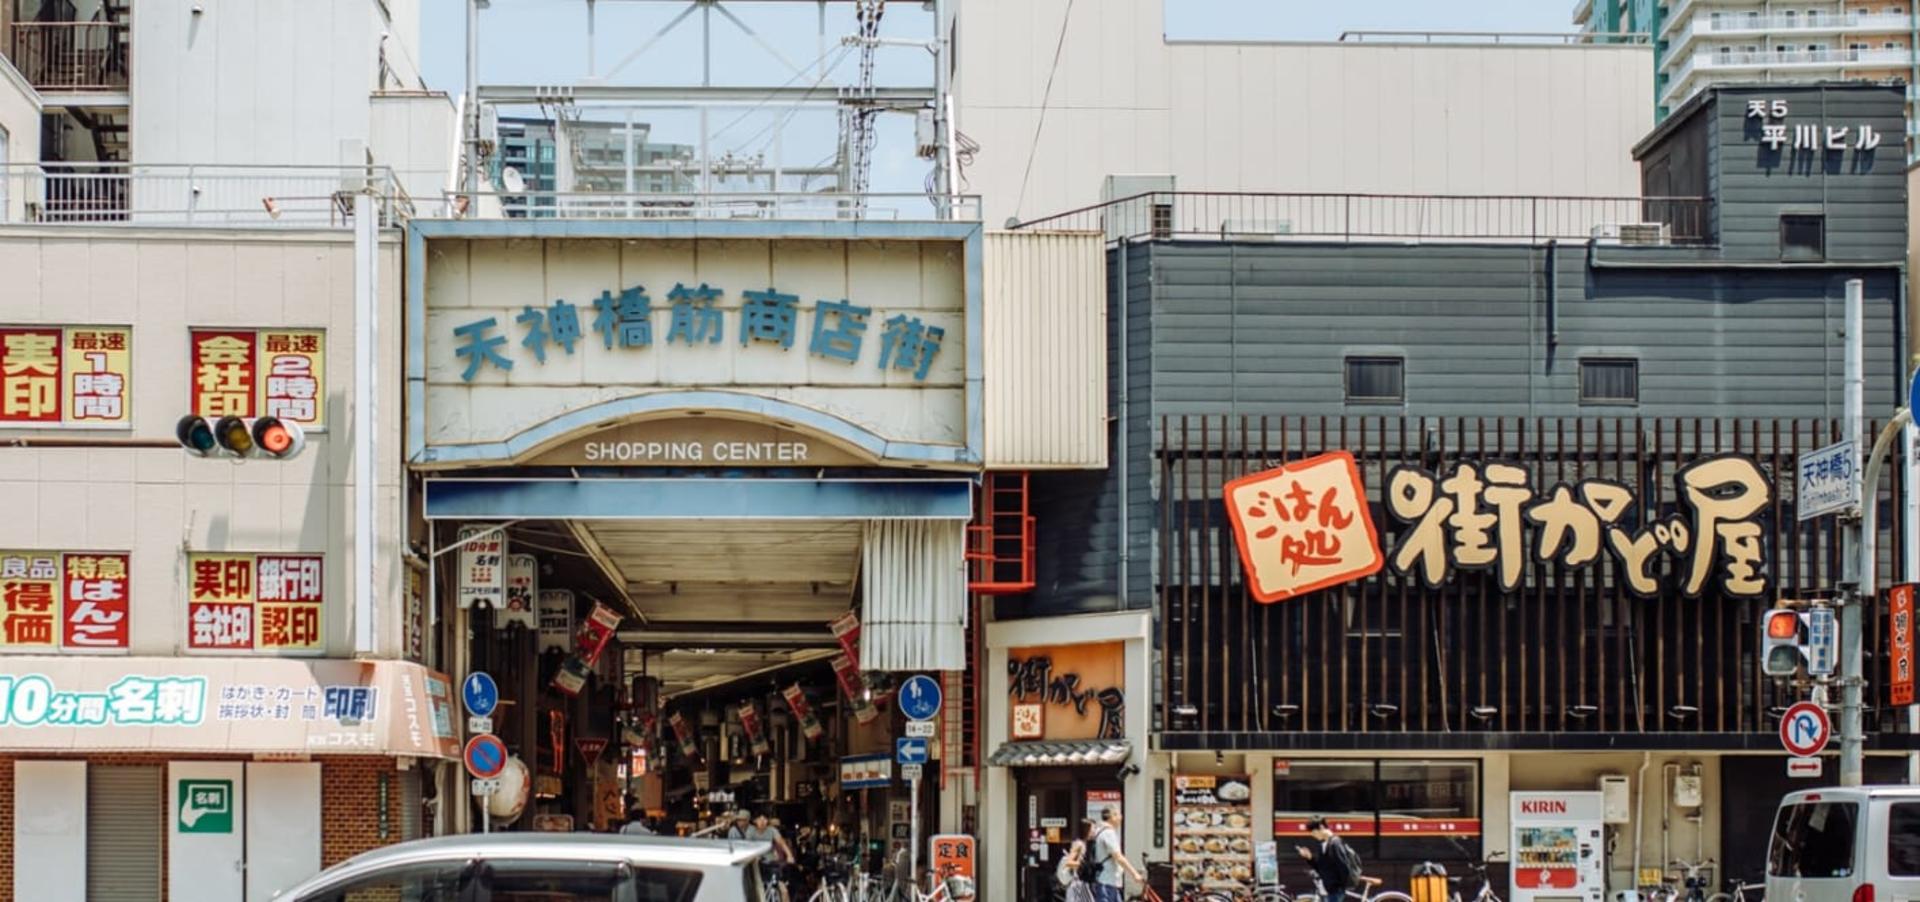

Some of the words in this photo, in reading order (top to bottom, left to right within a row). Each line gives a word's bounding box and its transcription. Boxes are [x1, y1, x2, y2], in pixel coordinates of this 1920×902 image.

[1748, 100, 1788, 117] 天5
[1761, 125, 1880, 149] 平川ビル
[72, 331, 126, 351] 最速
[265, 332, 319, 354] 最速
[453, 281, 945, 381] 天神橋筋商店街
[2, 332, 59, 418] 実印
[72, 352, 125, 420] 1時間
[197, 336, 251, 417] 会社印
[584, 442, 703, 461] SHOPPING
[712, 442, 808, 461] CENTER
[1248, 480, 1354, 540] ごはん
[1388, 453, 1770, 597] 街かど屋
[1, 557, 57, 580] 良品
[67, 556, 127, 580] 特急
[1281, 532, 1342, 577] 処
[194, 559, 252, 599] 実印
[257, 558, 323, 602] 銀行印
[1, 581, 55, 645] 得価
[68, 579, 124, 646] はんこ
[192, 605, 252, 645] 会社印
[262, 606, 319, 647] 認印
[323, 686, 377, 720] 印刷
[1008, 656, 1125, 739] 街かど屋
[1521, 801, 1567, 814] KIRIN
